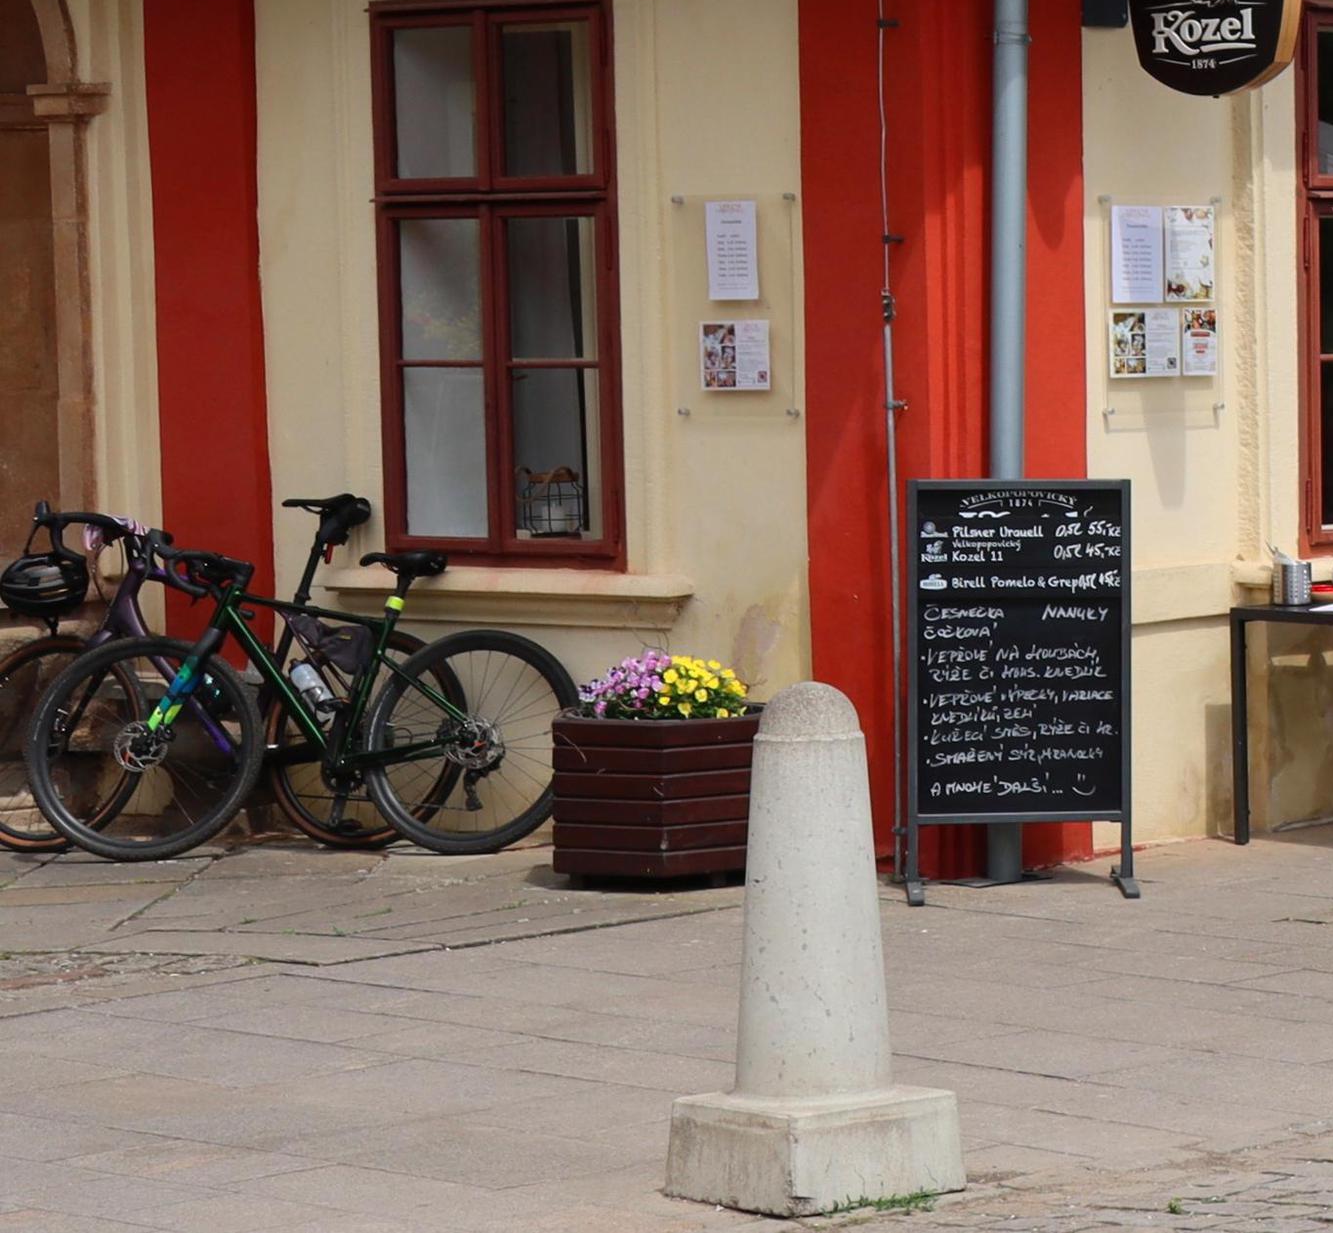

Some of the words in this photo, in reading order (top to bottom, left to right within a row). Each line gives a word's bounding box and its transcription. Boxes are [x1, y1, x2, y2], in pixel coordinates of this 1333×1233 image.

[1151, 8, 1256, 55] Kozel
[1191, 59, 1217, 69] 1874
[952, 526, 996, 538] Pilsner
[952, 539, 1021, 552] Velkopopovický
[952, 550, 985, 562] Kozel
[991, 551, 1004, 562] 11
[952, 576, 985, 588] Birell
[990, 576, 1035, 588] Pomelo
[1037, 576, 1046, 588] &
[923, 603, 1005, 621] ČESNEČKA
[1041, 604, 1109, 622] NANUKY
